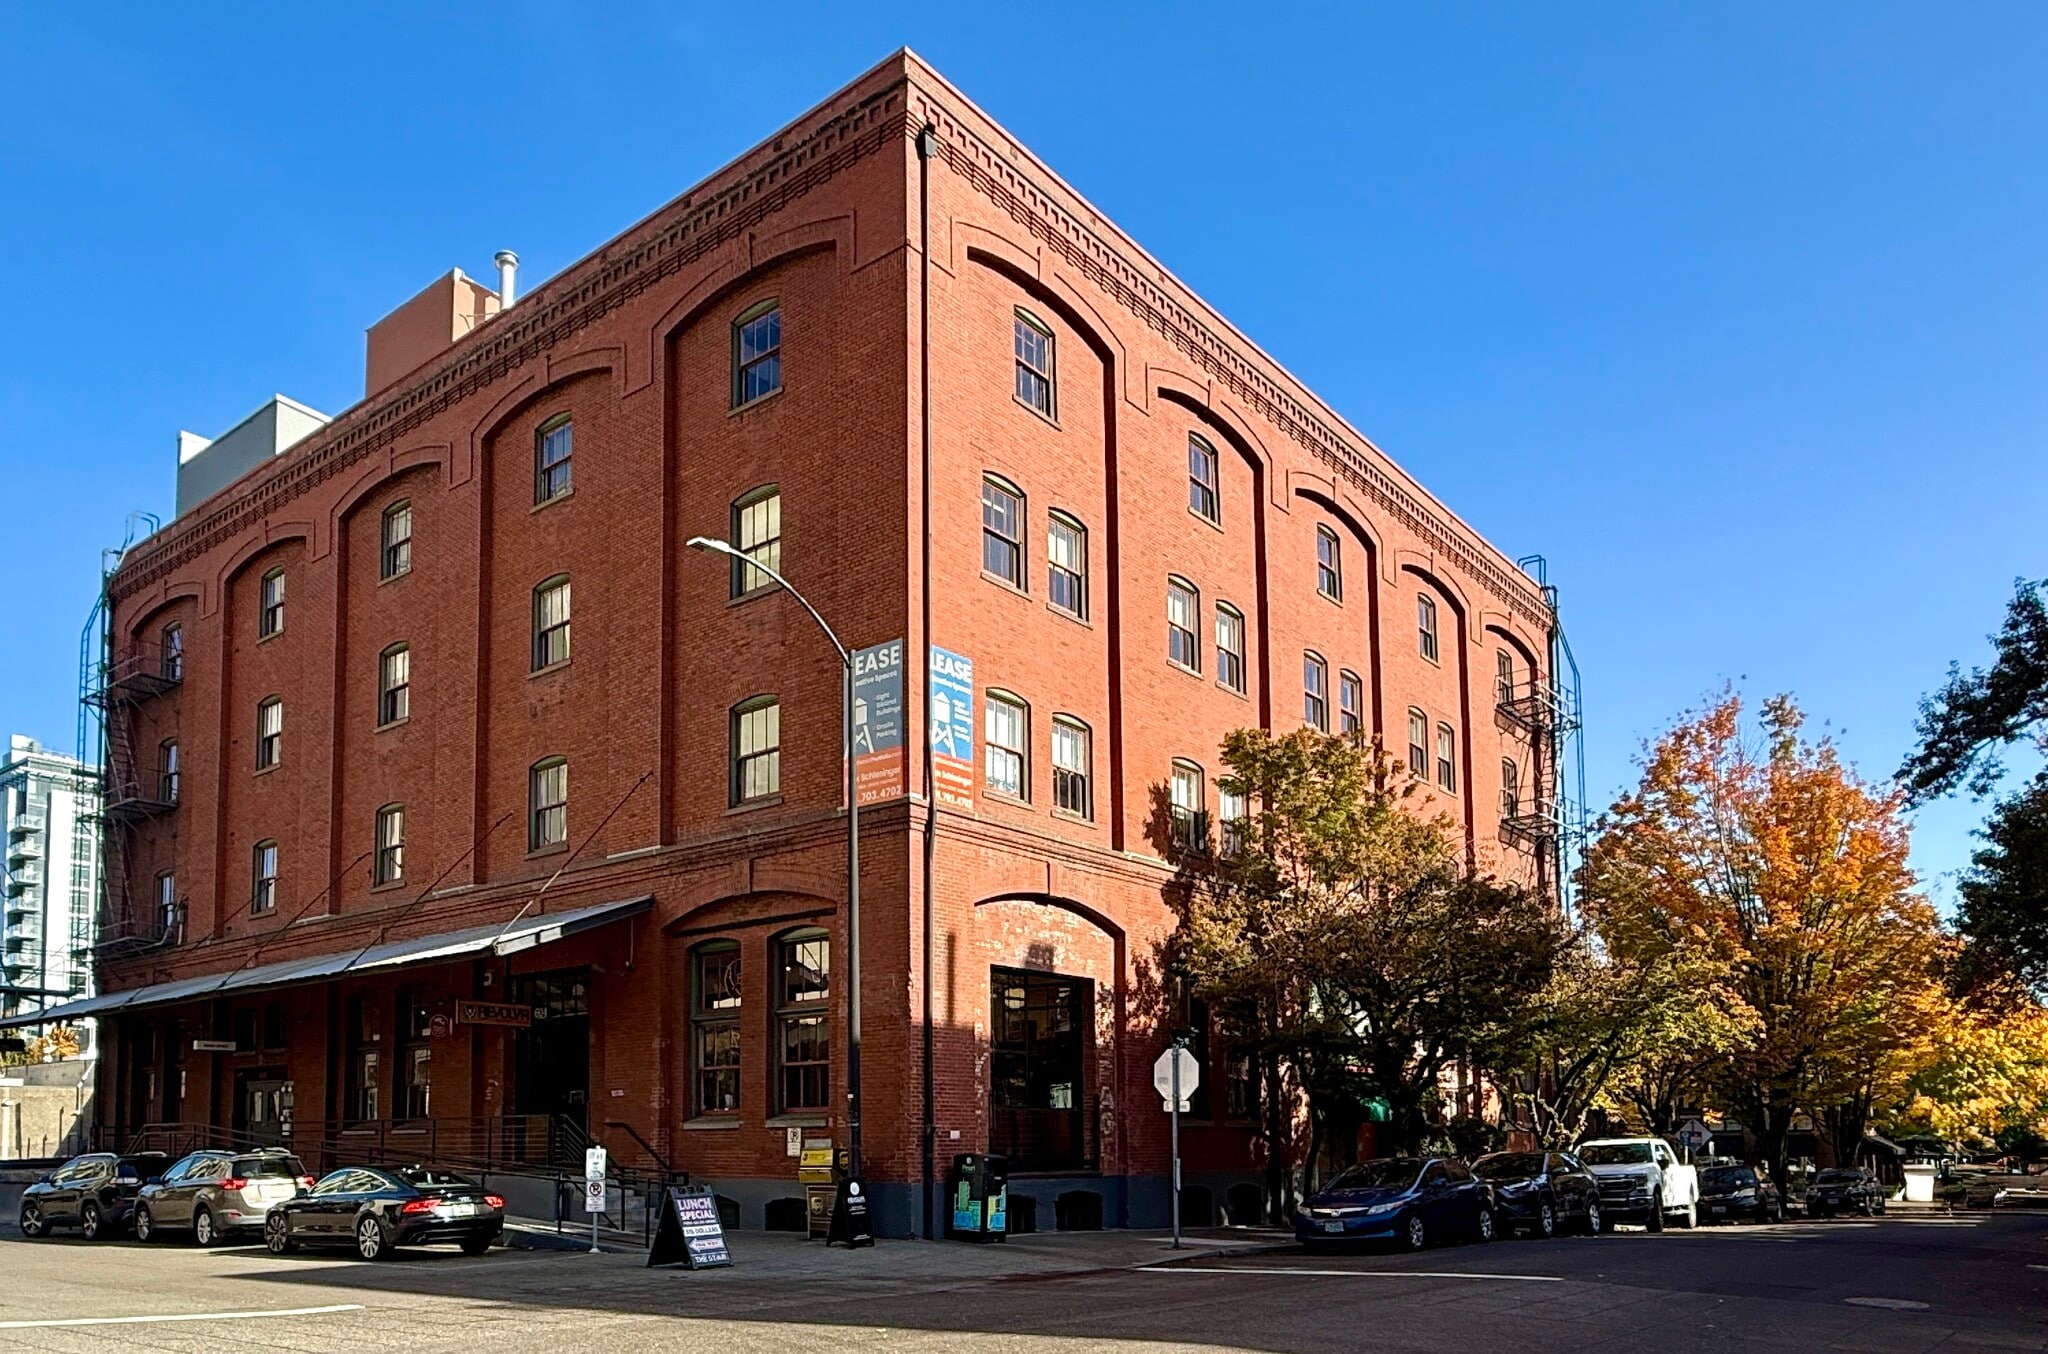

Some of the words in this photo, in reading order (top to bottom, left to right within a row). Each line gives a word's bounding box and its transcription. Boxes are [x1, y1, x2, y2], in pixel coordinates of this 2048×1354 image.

[855, 645, 900, 676] EASE
[677, 1198, 711, 1210] LUNCH
[680, 1209, 716, 1221] SPECIAL
